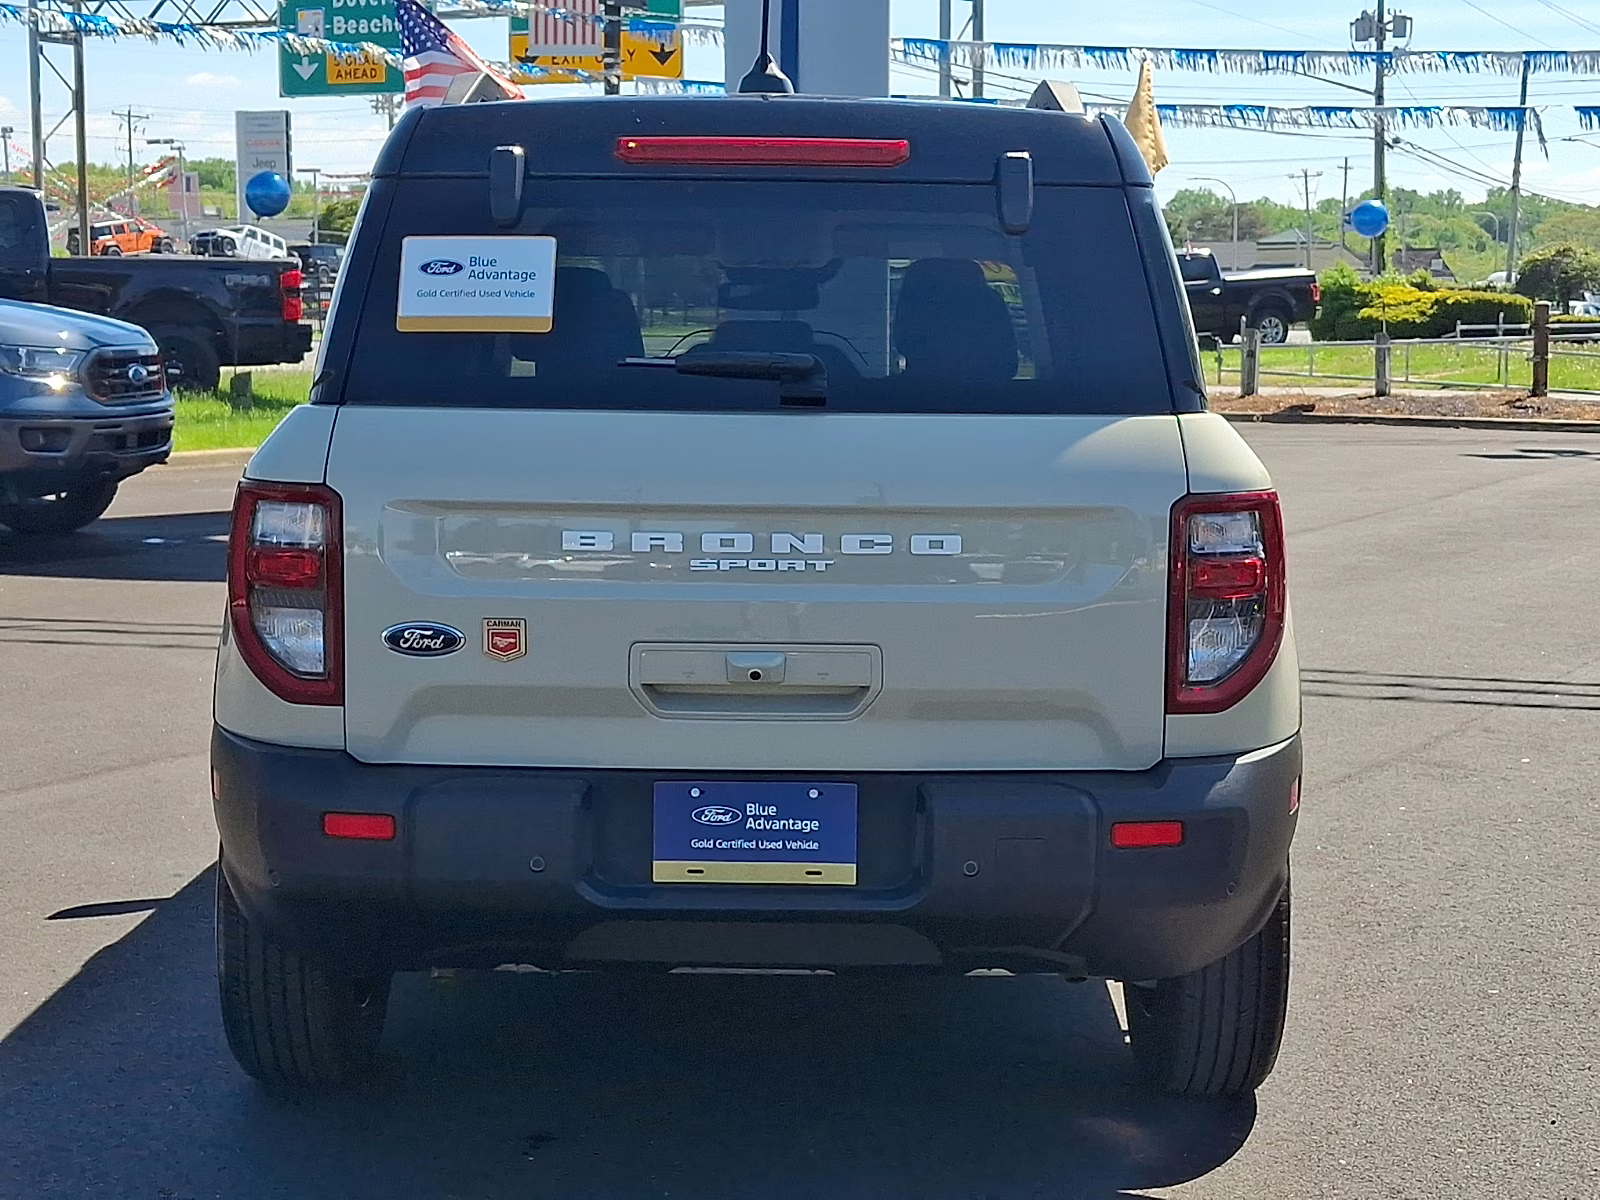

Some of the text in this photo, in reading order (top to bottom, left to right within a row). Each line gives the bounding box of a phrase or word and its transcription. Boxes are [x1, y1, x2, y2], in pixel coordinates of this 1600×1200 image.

[335, 67, 378, 80] AHEAD
[252, 156, 277, 170] Jeep
[469, 256, 498, 267] Blue
[468, 269, 537, 282] Advantage
[416, 289, 536, 298] Gold Certified Used Vehicle
[562, 530, 962, 555] BRONCO
[689, 559, 835, 571] SPORT
[486, 620, 521, 628] CARMAN
[746, 803, 777, 816] Blue
[745, 817, 820, 833] Advantage
[690, 838, 820, 850] Gold Certified Used Vehicle
